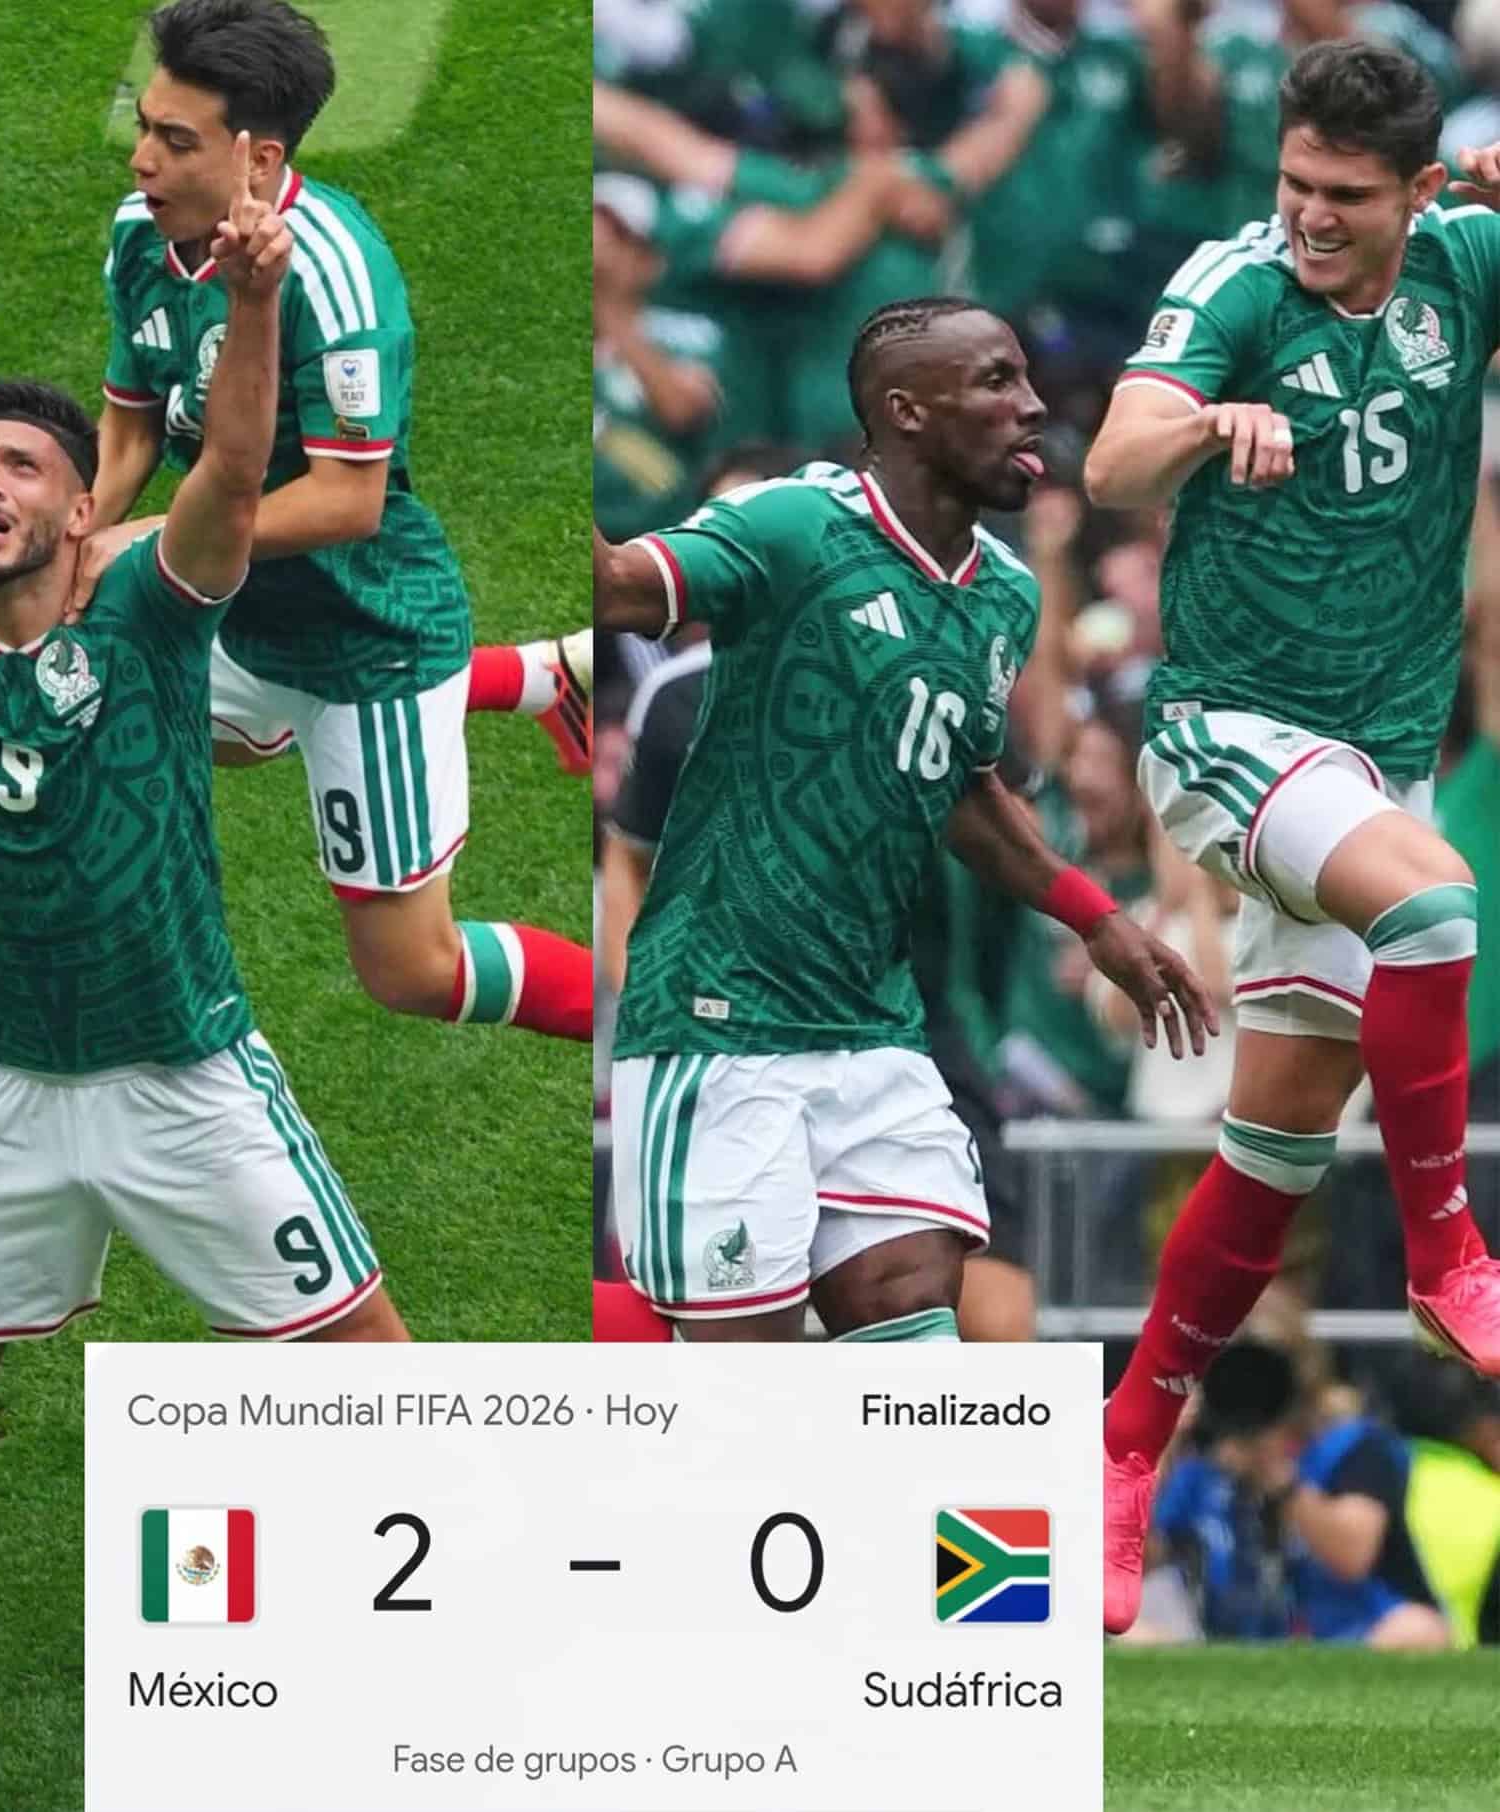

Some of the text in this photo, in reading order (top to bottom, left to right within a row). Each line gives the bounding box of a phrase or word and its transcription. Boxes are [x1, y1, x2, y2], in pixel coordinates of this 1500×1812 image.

[1339, 391, 1408, 494] 15
[897, 677, 967, 781] 16
[274, 1215, 333, 1296] 9
